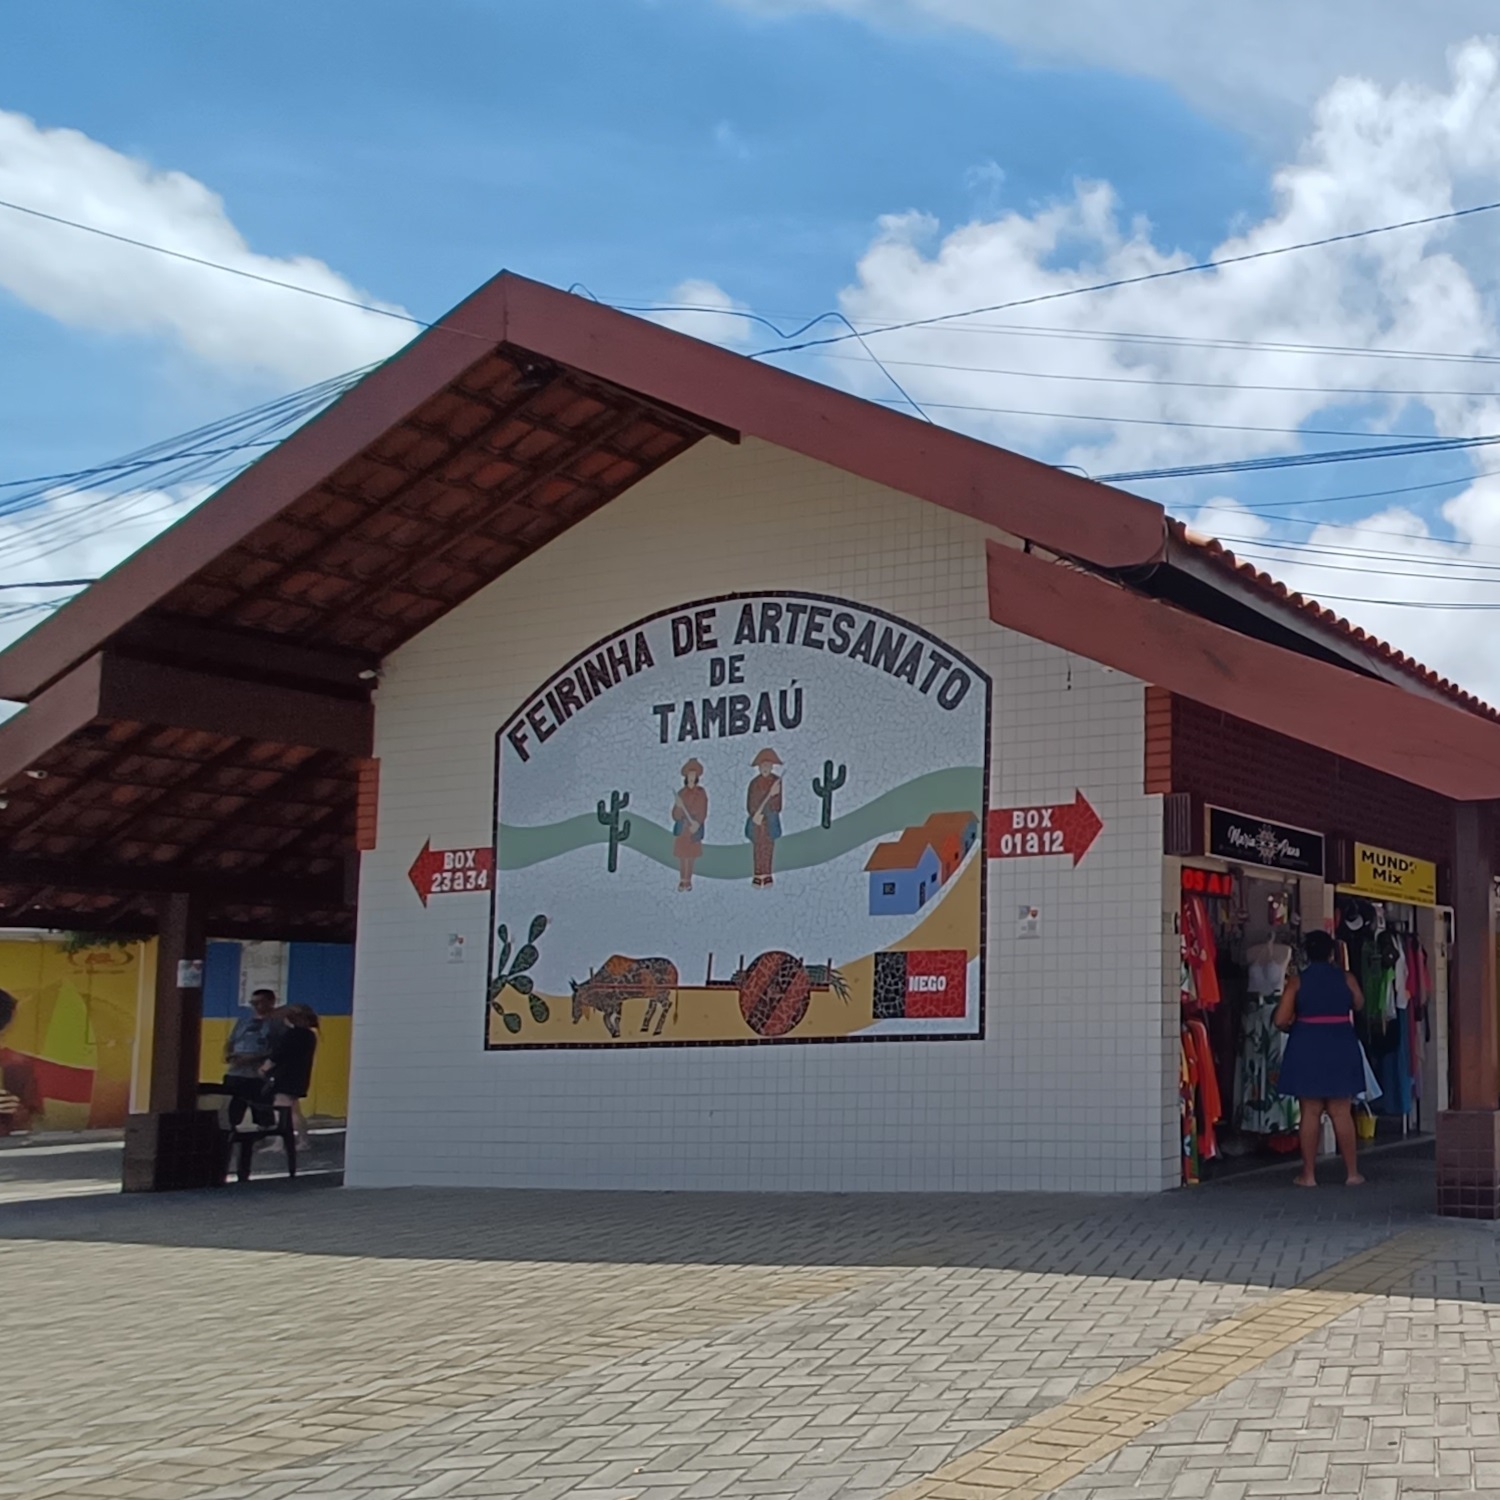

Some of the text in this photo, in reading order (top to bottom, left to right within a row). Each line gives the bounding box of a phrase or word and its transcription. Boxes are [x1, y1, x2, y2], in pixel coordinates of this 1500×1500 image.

[709, 653, 745, 687] DE
[506, 602, 971, 763] FEIRINHA DE ARTESANATO
[652, 679, 803, 744] TAMBAÚ
[1012, 808, 1053, 829] BOX
[443, 850, 476, 870] BOX
[1373, 867, 1402, 885] Mix
[909, 975, 946, 992] NEGO
